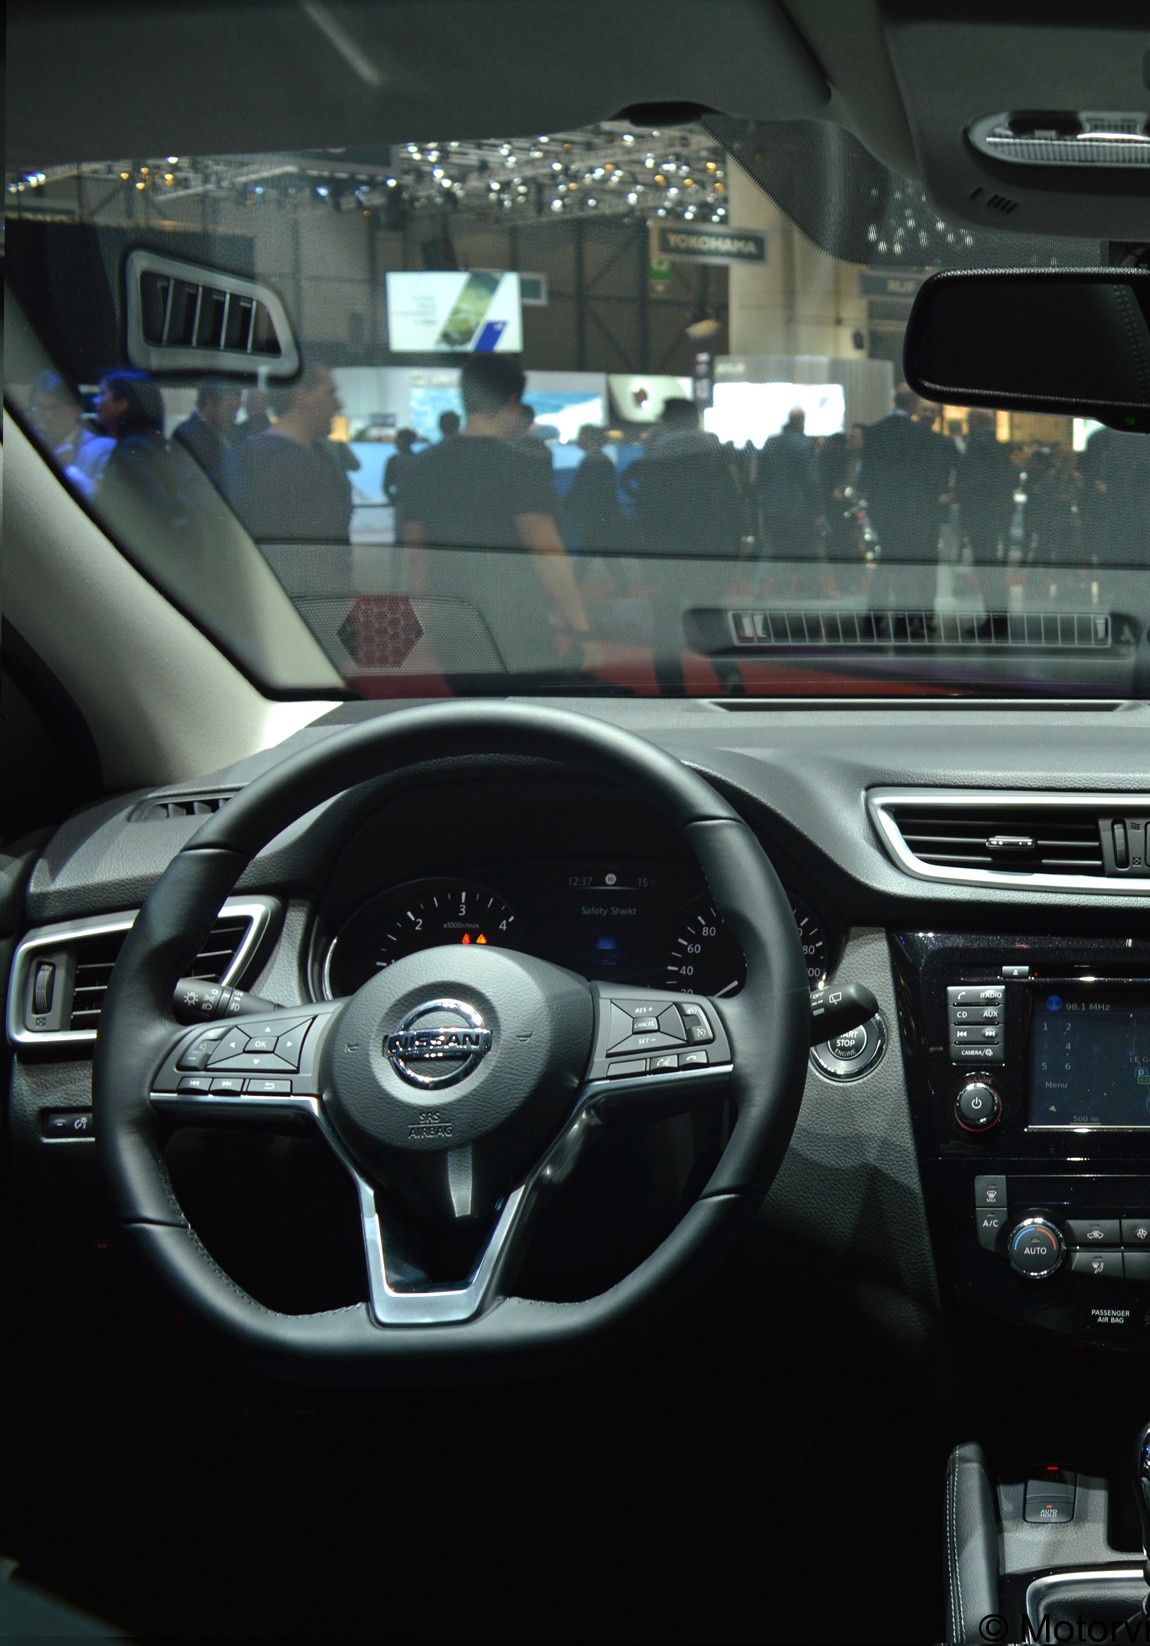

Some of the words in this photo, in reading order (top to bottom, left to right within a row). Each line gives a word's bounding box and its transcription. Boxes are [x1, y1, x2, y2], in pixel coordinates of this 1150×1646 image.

[666, 232, 760, 255] YOKOHAMA
[568, 876, 593, 887] 12:37
[638, 877, 649, 888] 15
[458, 904, 466, 916] 3
[580, 905, 608, 917] Safety
[610, 906, 637, 916] Shield
[414, 918, 423, 931] 2
[498, 919, 507, 931] 4
[701, 926, 717, 937] 80
[687, 943, 701, 954] 60
[679, 965, 694, 976] 40
[812, 991, 825, 1000] OFF
[980, 991, 1003, 999] RADIO
[634, 1006, 647, 1014] RES
[1065, 1002, 1087, 1011] 98.1
[1089, 1002, 1111, 1011] MHz
[982, 1010, 999, 1018] AUX
[634, 1020, 656, 1030] CANCEL
[1042, 1022, 1049, 1031] 1
[1065, 1022, 1072, 1031] 2
[840, 1030, 859, 1039] ART
[254, 1040, 267, 1048] OK
[389, 1033, 481, 1053] NISSAN
[638, 1037, 650, 1045] SET
[836, 1039, 856, 1048] STOP
[1065, 1042, 1072, 1051] 4
[834, 1047, 857, 1058] ENGINE
[1129, 1056, 1138, 1064] LE
[1041, 1062, 1048, 1071] 5
[1064, 1062, 1071, 1071] 6
[1045, 1081, 1068, 1089] Menu
[419, 1111, 441, 1124] SRS
[408, 1126, 453, 1140] AIRBAG
[982, 1219, 999, 1228] A/C
[1023, 1246, 1047, 1255] AUTO
[1091, 1308, 1131, 1317] PASSENGER
[1097, 1316, 1109, 1324] AIR
[1110, 1316, 1125, 1324] BAG
